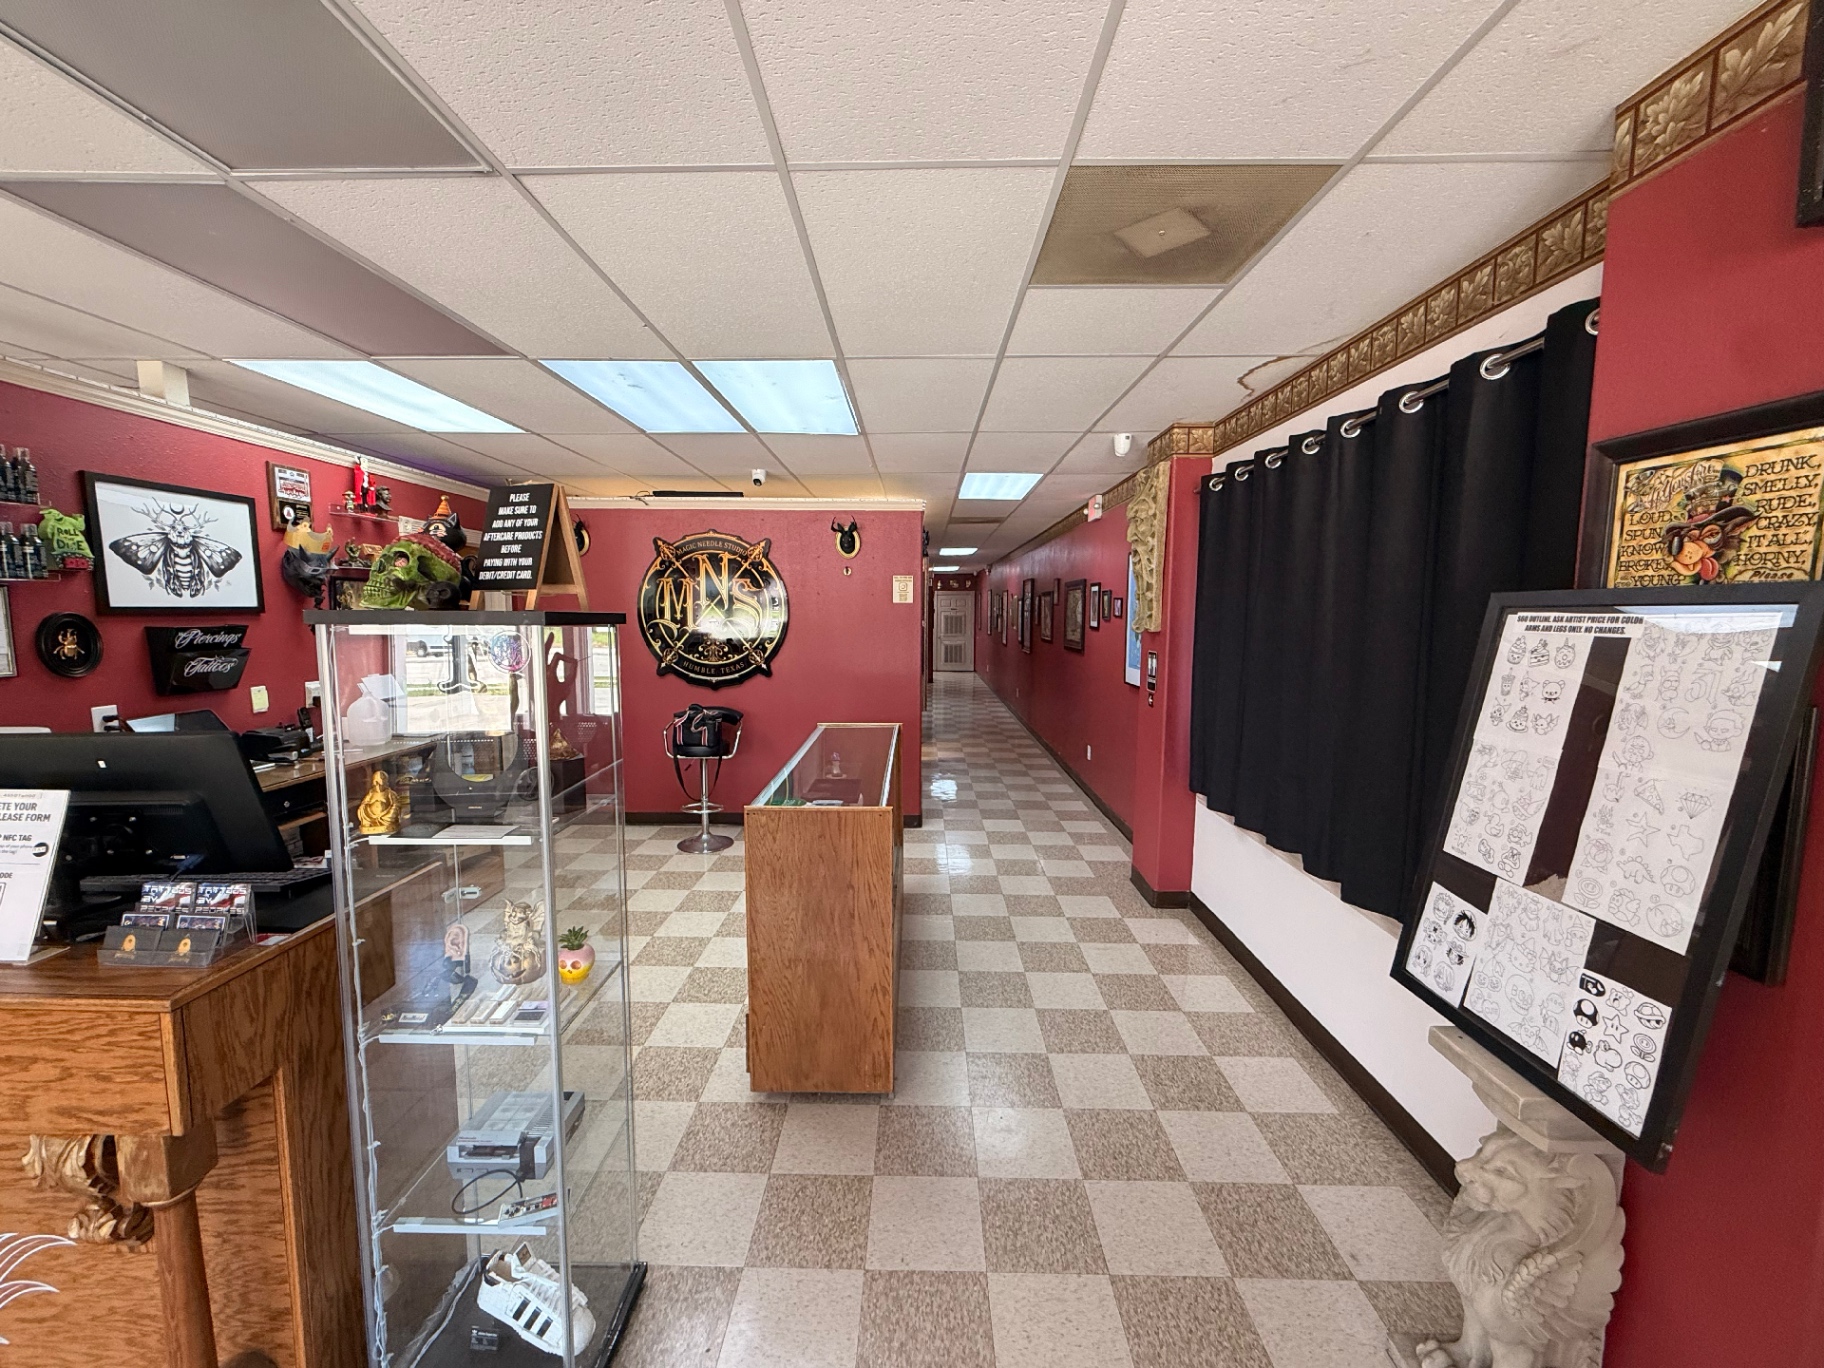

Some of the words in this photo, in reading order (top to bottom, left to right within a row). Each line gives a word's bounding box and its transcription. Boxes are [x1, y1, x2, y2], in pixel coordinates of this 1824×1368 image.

[1744, 455, 1821, 478] DRUNK,
[1742, 473, 1821, 497] SMELLY,
[509, 493, 530, 502] PLEASE
[1754, 493, 1817, 514] RUDE,
[498, 506, 514, 516] MAKE
[514, 505, 528, 515] SURE
[530, 505, 537, 514] TO
[492, 519, 503, 529] ADD
[504, 519, 515, 528] ANY
[516, 518, 523, 527] OF
[524, 518, 539, 527] YOUR
[1755, 511, 1820, 531] CRAZY,
[483, 531, 514, 541] AFTERCARE
[514, 530, 543, 540] PRODUCTS
[1746, 534, 1765, 549] IT
[500, 544, 522, 553] BEFORE
[676, 542, 697, 556] MAGIC
[697, 540, 723, 548] NEEDLE
[724, 543, 748, 556] STUDIO
[483, 558, 502, 567] PAYING
[503, 558, 517, 567] WITH
[519, 557, 533, 566] YOUR
[1734, 549, 1807, 568] HORNY,
[479, 571, 516, 580] DEBIT/CREDIT
[516, 570, 532, 579] CARD.
[1748, 569, 1794, 580] Please
[1587, 616, 1606, 624] PRICE
[1606, 616, 1620, 624] FOR
[1620, 616, 1644, 625] COLOR
[1594, 627, 1626, 635] CHANGES.
[174, 629, 242, 649] Piercings
[184, 656, 238, 677] Tattoos
[683, 661, 716, 674] HUMBLE
[721, 662, 745, 674] TEXAS
[0, 802, 12, 811] TE
[14, 802, 38, 811] YOUR
[25, 814, 51, 822] FORM
